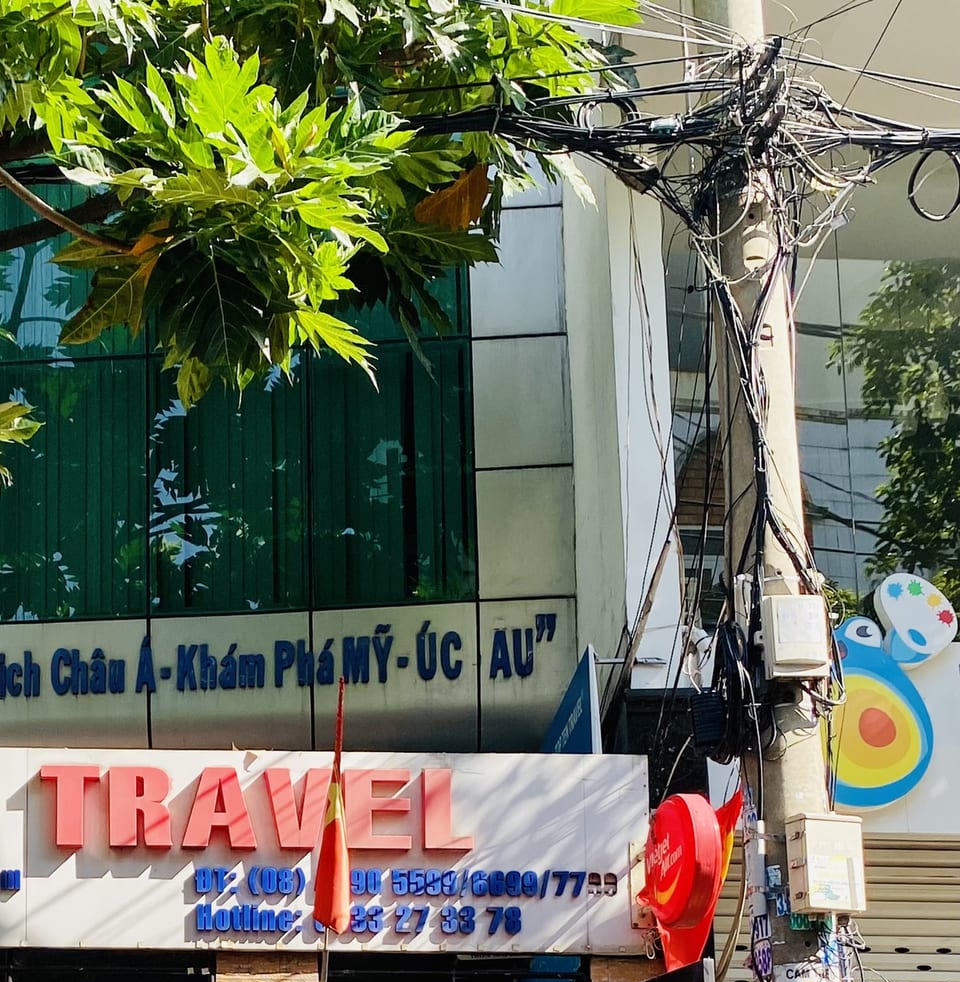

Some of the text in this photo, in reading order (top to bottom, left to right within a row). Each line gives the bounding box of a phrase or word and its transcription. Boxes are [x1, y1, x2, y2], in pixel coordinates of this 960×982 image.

[51, 647, 125, 696] Châu
[274, 638, 334, 688] Phá
[40, 765, 475, 851] TRAVEL
[195, 866, 238, 894] ĐT:
[248, 866, 306, 896] (08)
[196, 903, 304, 932] Hotline:
[395, 906, 430, 934] 27
[441, 906, 476, 934] 33
[486, 906, 522, 934] 78
